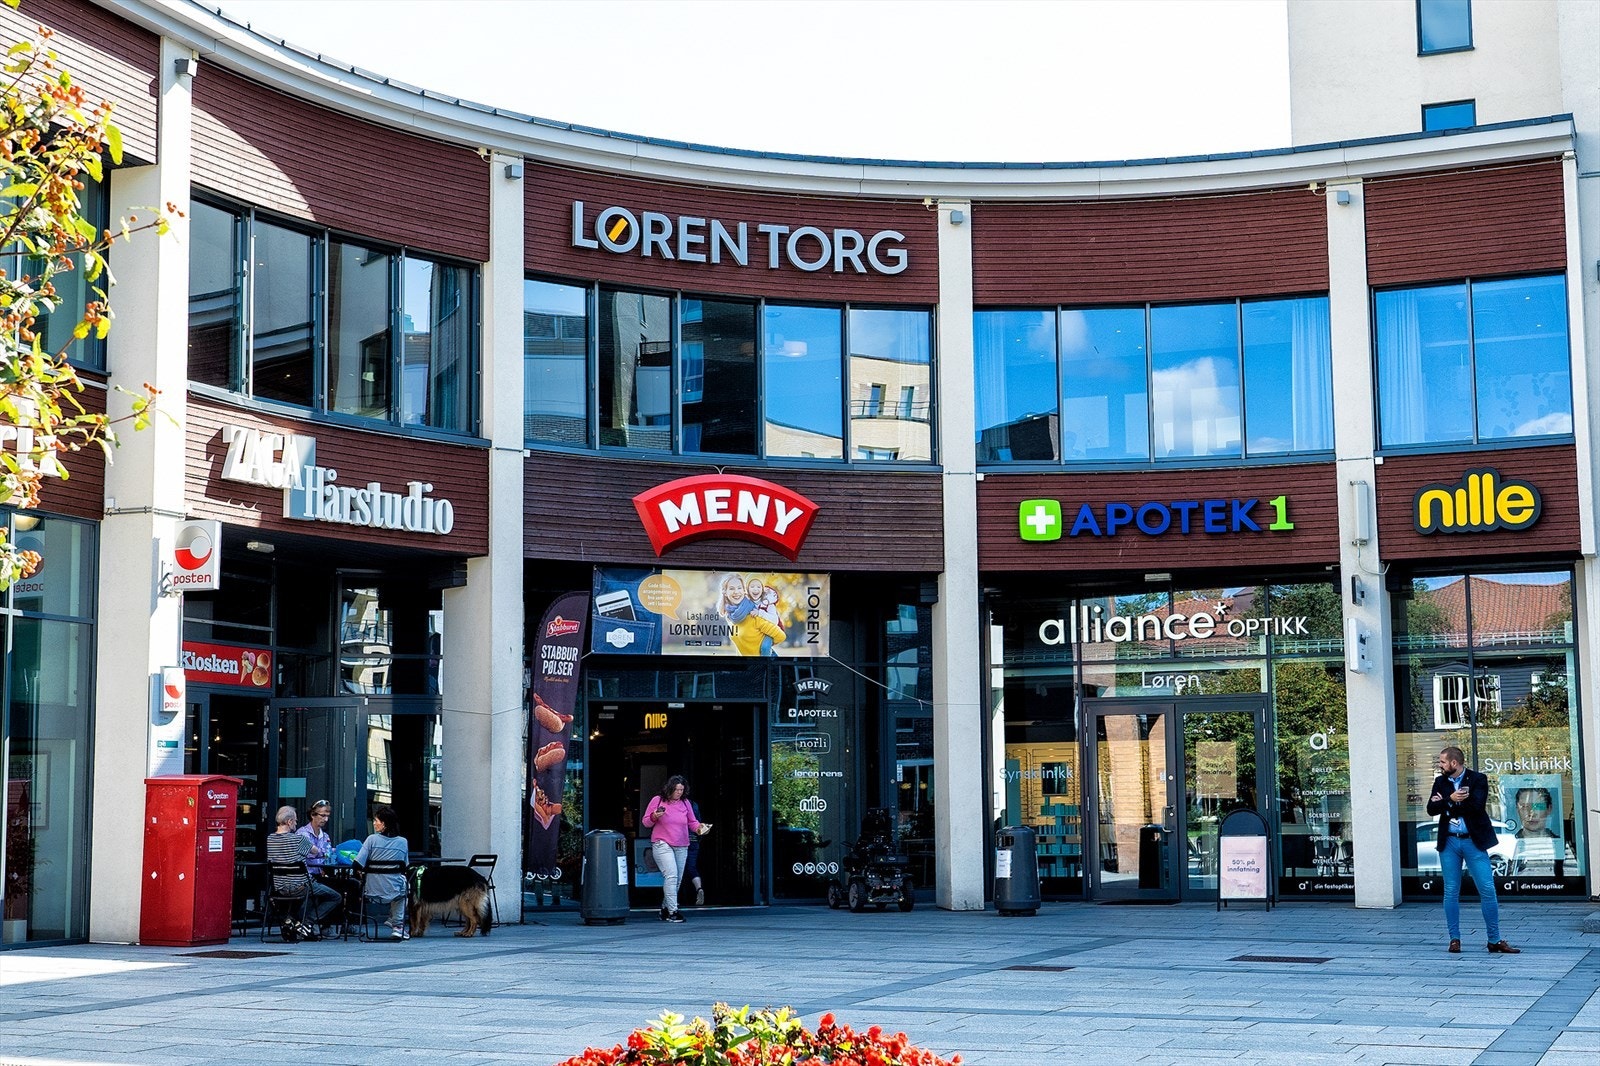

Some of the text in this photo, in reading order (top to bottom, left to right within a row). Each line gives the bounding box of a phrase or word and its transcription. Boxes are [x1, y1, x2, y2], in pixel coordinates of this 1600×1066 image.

[572, 200, 909, 275] LØREN TORG
[304, 464, 454, 535] Hårstudio
[1418, 472, 1535, 528] nille
[658, 489, 804, 535] MENY
[1070, 495, 1296, 538] APOTEK 1
[173, 572, 212, 586] posten
[687, 611, 719, 621] Last ned
[669, 624, 739, 637] LØRENVENN!
[1227, 615, 1309, 638] OPTIKK
[541, 645, 579, 662] STABBUR
[182, 651, 239, 675] Kiosken
[542, 660, 574, 676] PØLSER
[797, 681, 829, 691] MENY
[1141, 671, 1200, 689] Løren
[645, 713, 667, 729] nille
[798, 709, 838, 717] APOTEK 1
[800, 737, 827, 748] norli
[1484, 756, 1572, 774] Synsklinikk
[800, 797, 826, 811] nille
[1246, 858, 1255, 866] på
[1531, 883, 1565, 891] fastoptiker
